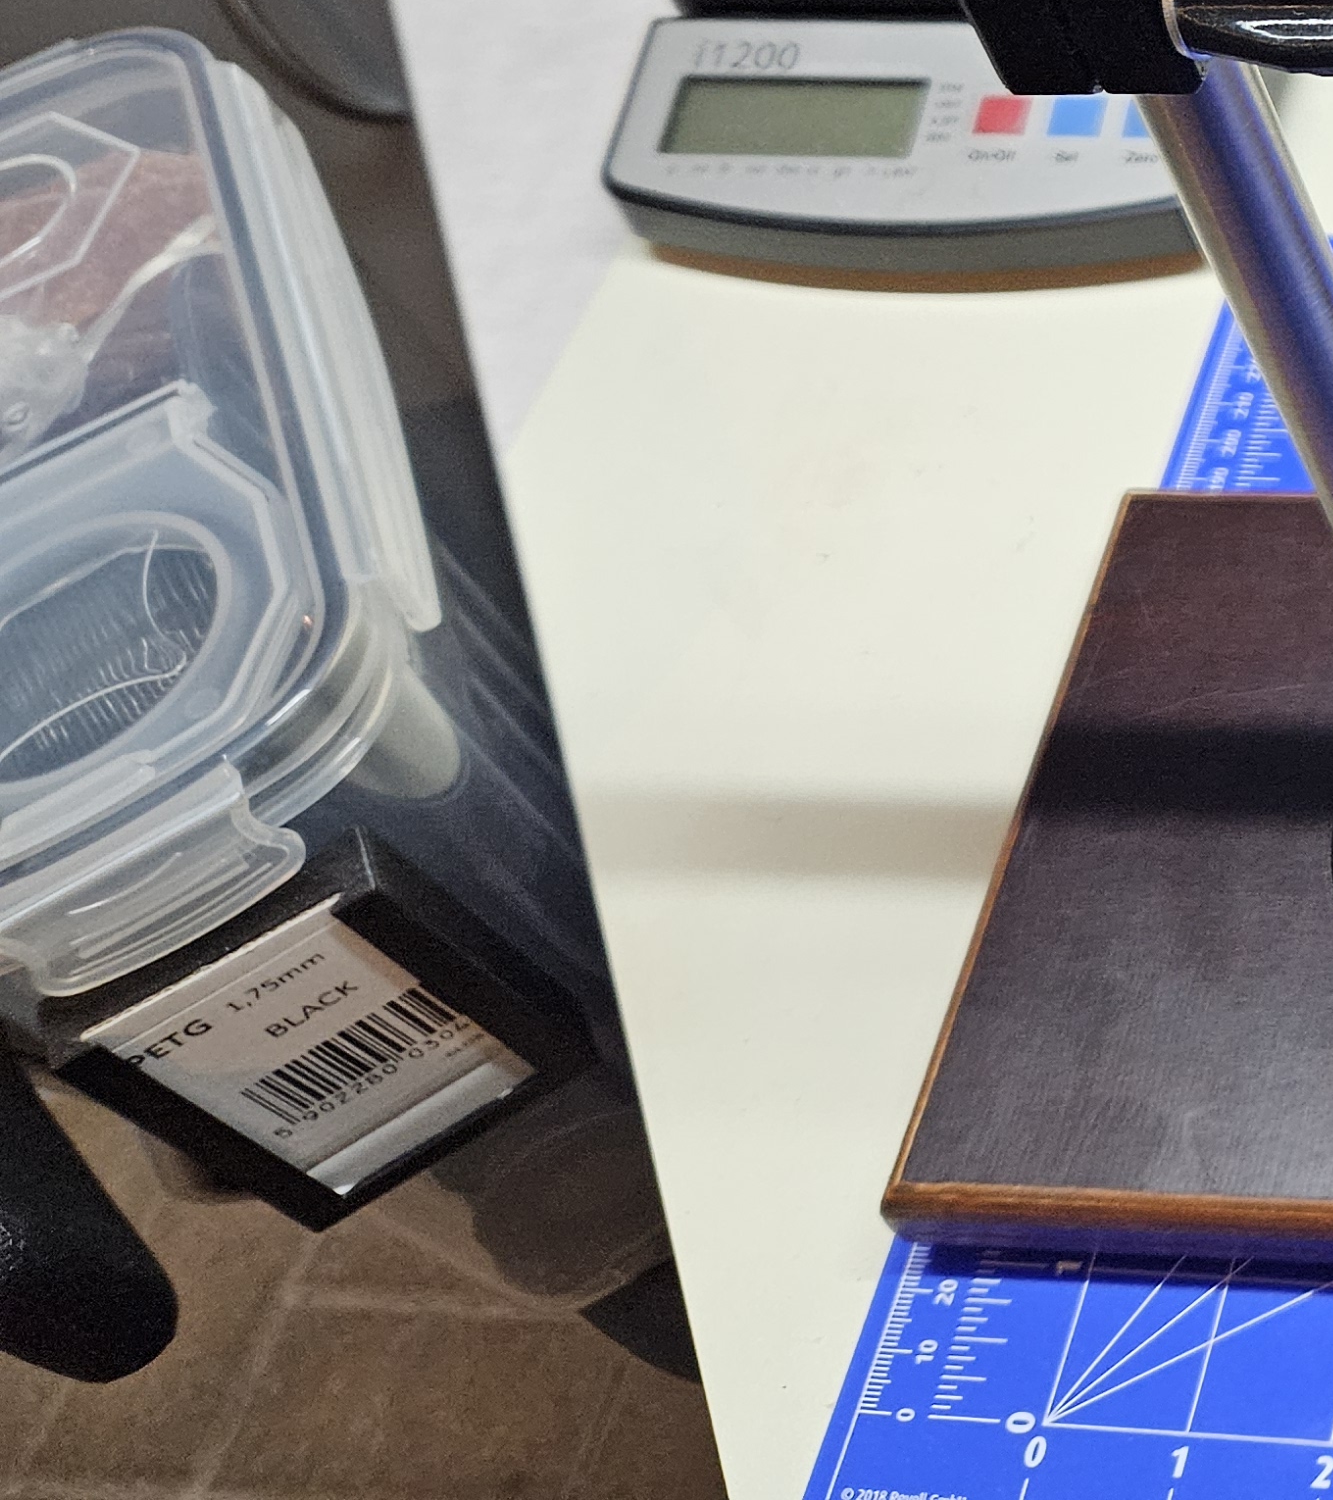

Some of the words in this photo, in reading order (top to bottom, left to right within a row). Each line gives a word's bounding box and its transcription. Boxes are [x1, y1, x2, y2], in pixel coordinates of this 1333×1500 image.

[126, 1017, 214, 1066] PETG
[225, 951, 326, 1015] 1,75mm
[263, 979, 360, 1040] BLACK
[302, 1061, 398, 1124] 902280
[932, 1278, 959, 1306] 20
[914, 1338, 939, 1365] 10
[1005, 1411, 1036, 1434] 0
[1023, 1435, 1047, 1468] 0
[1171, 1445, 1191, 1479] 1
